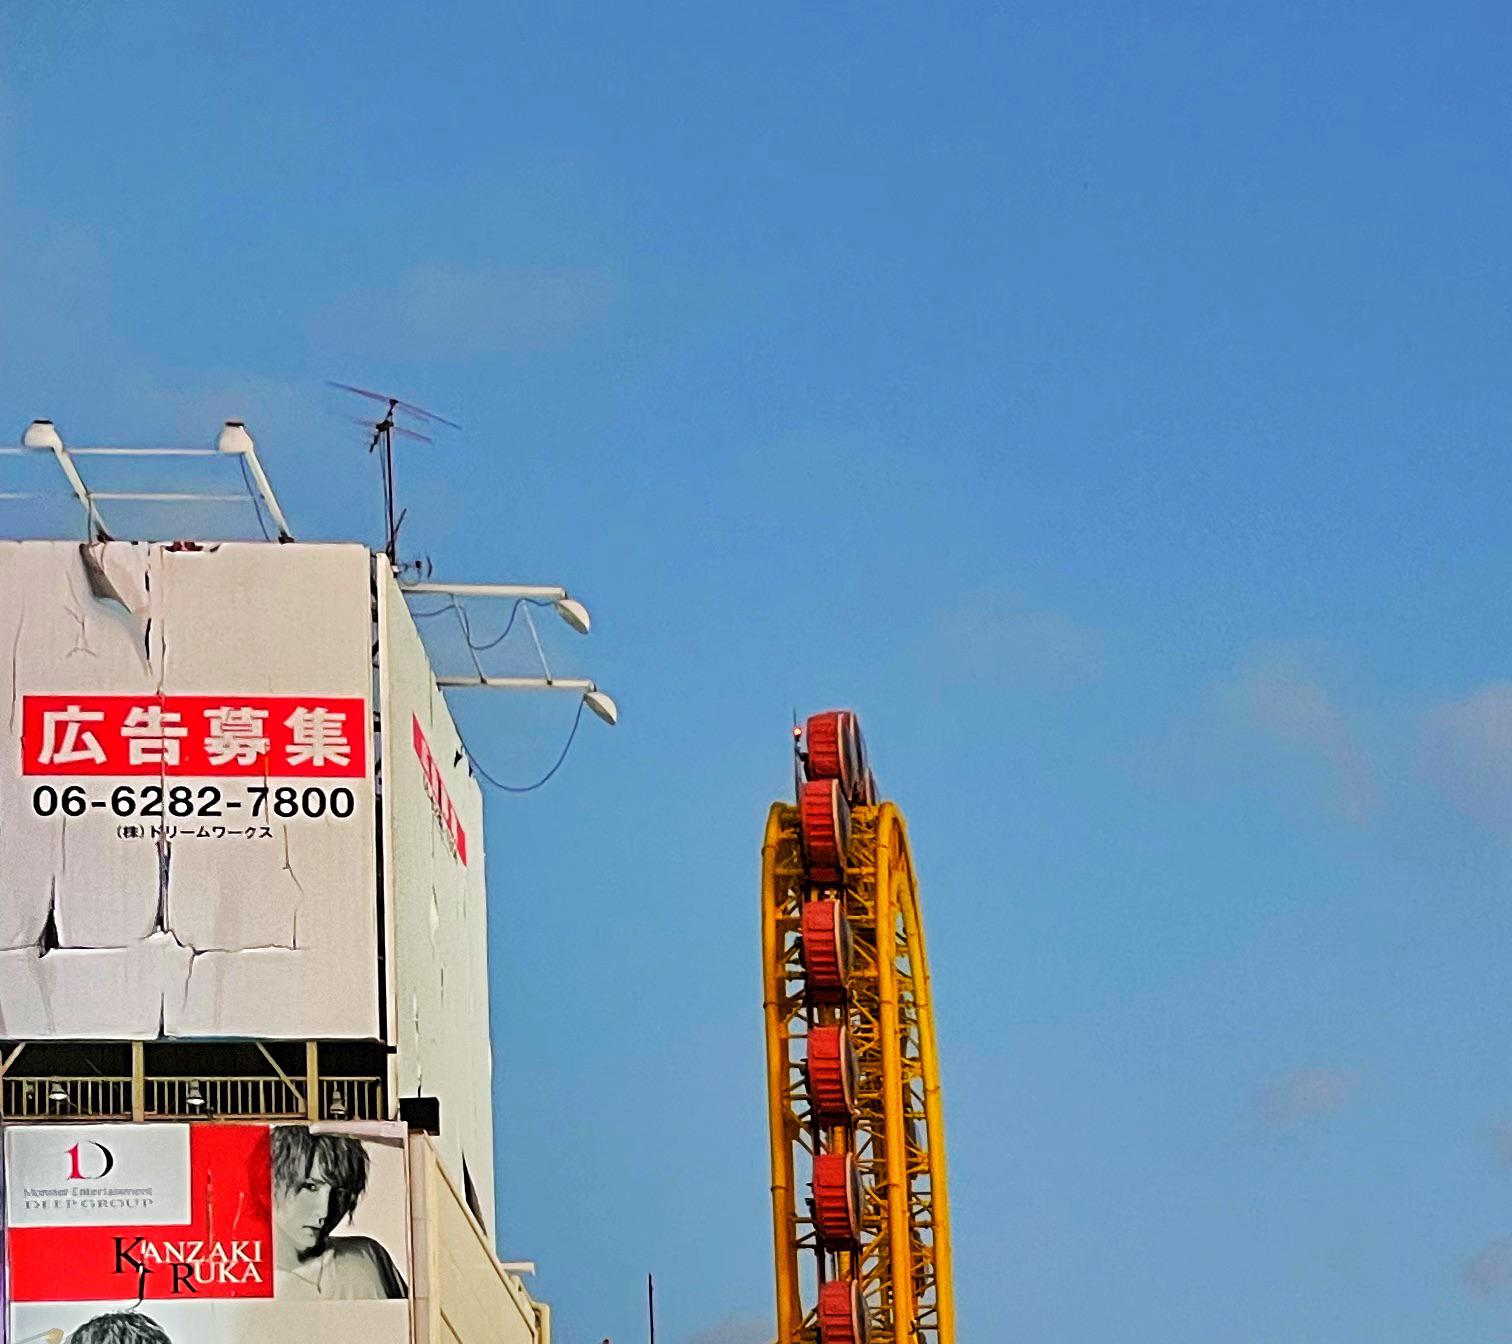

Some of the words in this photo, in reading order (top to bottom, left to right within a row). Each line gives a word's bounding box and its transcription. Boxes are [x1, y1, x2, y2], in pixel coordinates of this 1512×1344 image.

[37, 704, 352, 767] 広告募集
[32, 785, 356, 818] 06-6282-7800
[111, 1236, 263, 1275] KANZAKI
[170, 1261, 263, 1294] RUKA
